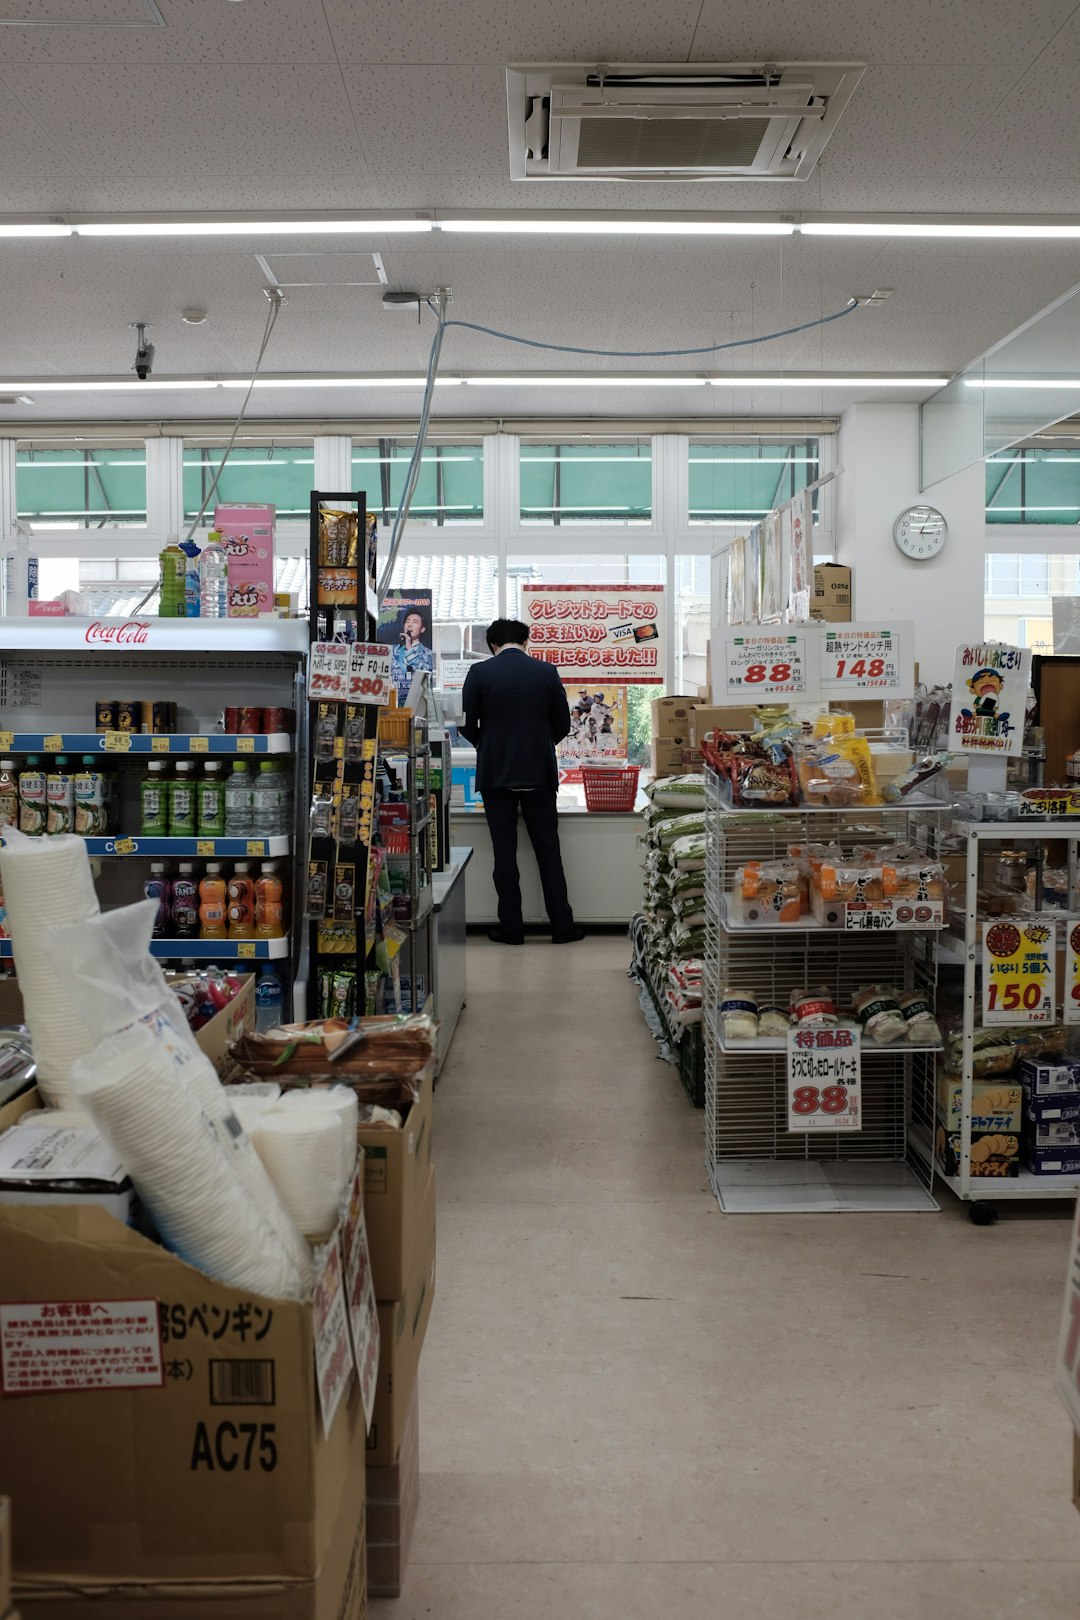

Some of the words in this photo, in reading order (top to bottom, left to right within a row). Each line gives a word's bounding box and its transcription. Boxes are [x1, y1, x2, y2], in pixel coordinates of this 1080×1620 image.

[529, 600, 657, 619] クレジットカードでの
[85, 621, 152, 643] Coca-Cola
[530, 623, 607, 643] お支払いが
[613, 628, 632, 638] VISA
[355, 643, 389, 656] 特価品
[826, 640, 892, 652] 超熟サンドイッチ用
[529, 647, 657, 666] 可能になりました!!
[962, 647, 1022, 671] おいしいおにぎり
[744, 664, 792, 684] 88
[835, 659, 885, 679] 148
[349, 677, 383, 695] 380
[1020, 801, 1067, 814] おにぎり各種
[847, 916, 894, 929] ビール酵母パン
[896, 906, 932, 922] 99
[990, 963, 1018, 974] いなり
[1022, 963, 1051, 974] 5個入
[988, 983, 1042, 1010] 150
[796, 1030, 853, 1048] 特価品
[792, 1086, 848, 1115] 88
[958, 1117, 1013, 1131] テトフライ
[41, 1304, 109, 1317] お客様へ
[190, 1421, 277, 1472] AC75
